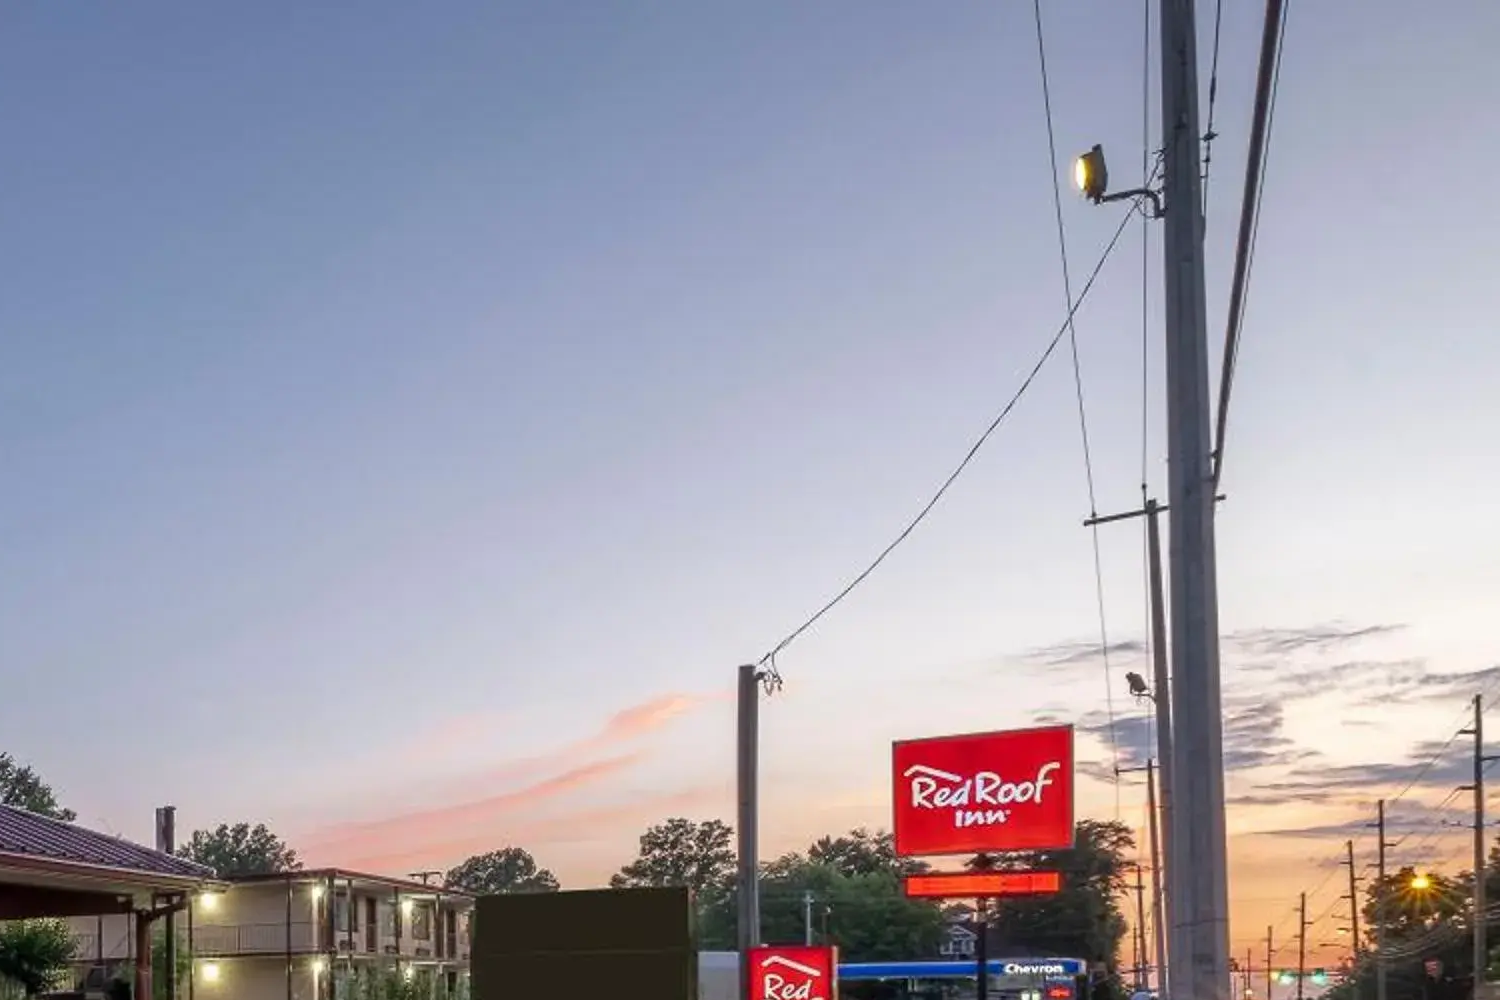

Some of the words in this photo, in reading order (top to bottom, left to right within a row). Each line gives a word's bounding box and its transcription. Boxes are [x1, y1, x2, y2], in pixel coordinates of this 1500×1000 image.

[911, 777, 972, 809] Red
[974, 762, 1061, 805] Roof
[1004, 963, 1064, 974] Chevron
[764, 974, 812, 1000] Red
